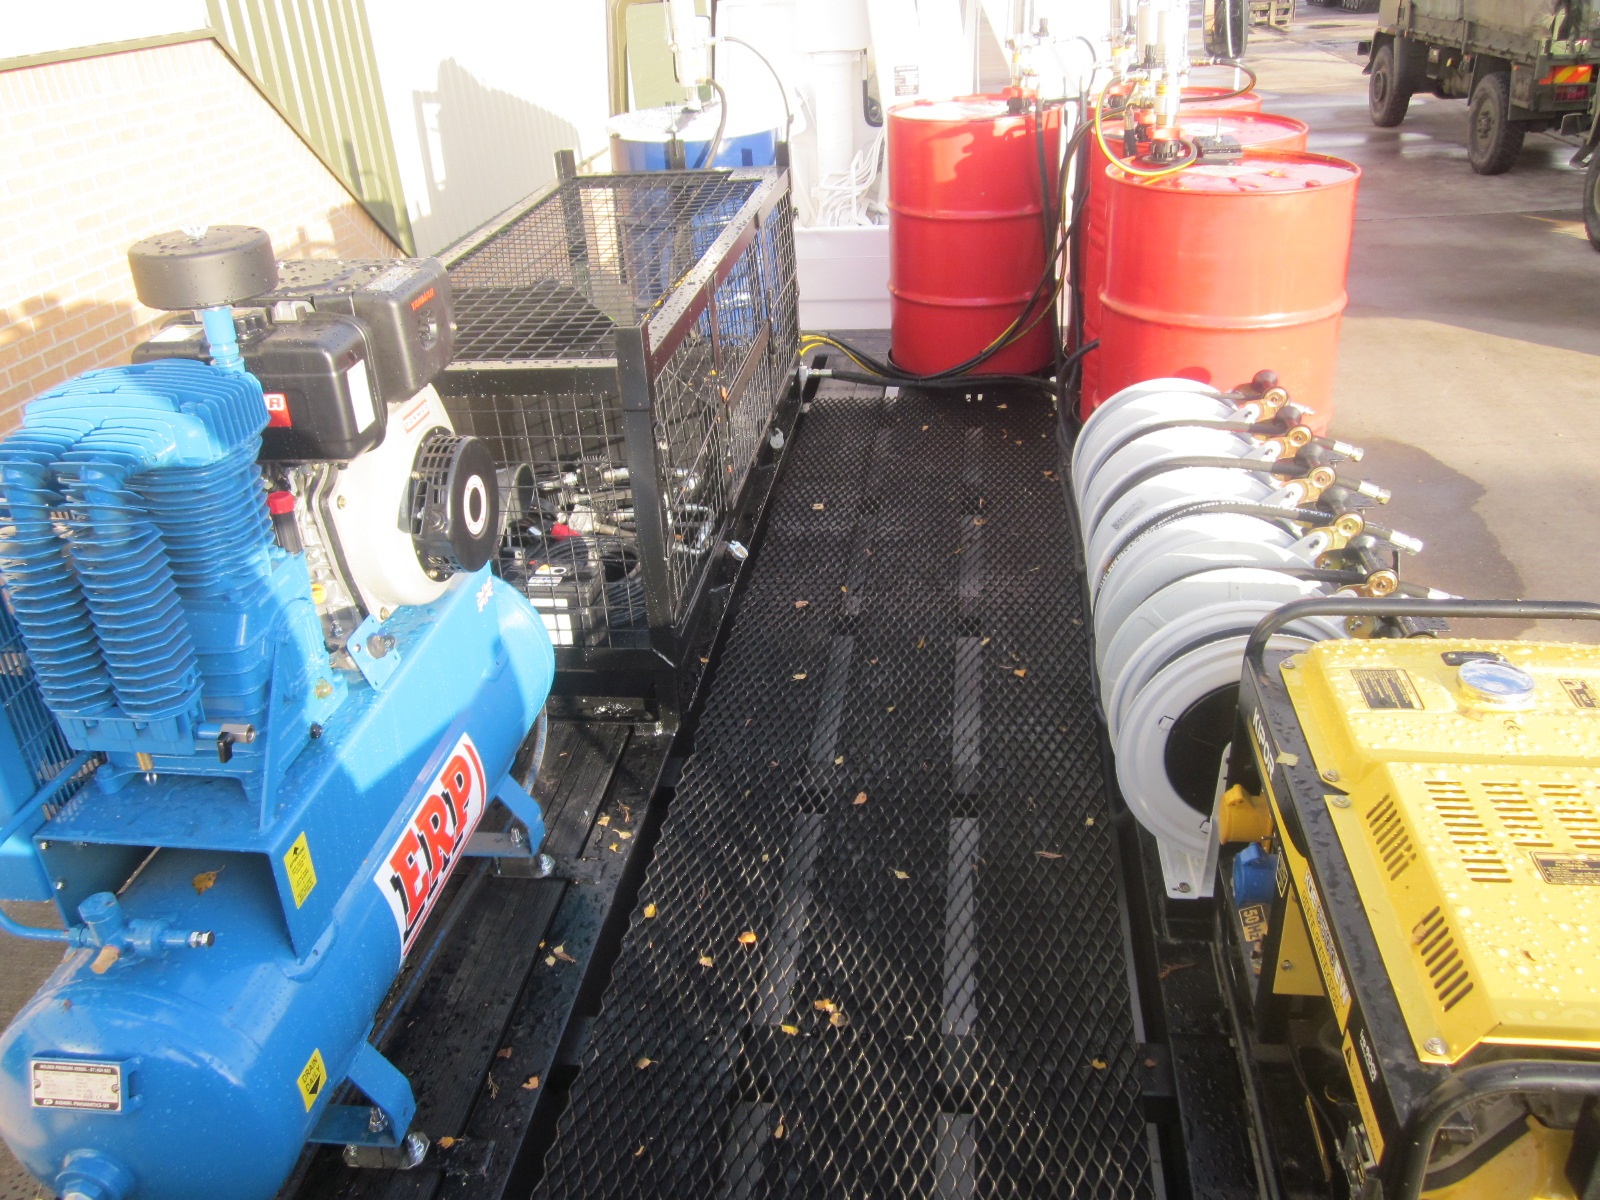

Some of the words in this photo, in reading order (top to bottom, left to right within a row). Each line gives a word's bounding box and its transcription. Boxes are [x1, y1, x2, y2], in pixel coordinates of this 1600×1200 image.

[1252, 706, 1275, 782] KIPOR
[389, 754, 472, 938] ERP
[302, 1056, 318, 1084] DRAIN
[305, 1064, 320, 1092] DAILY
